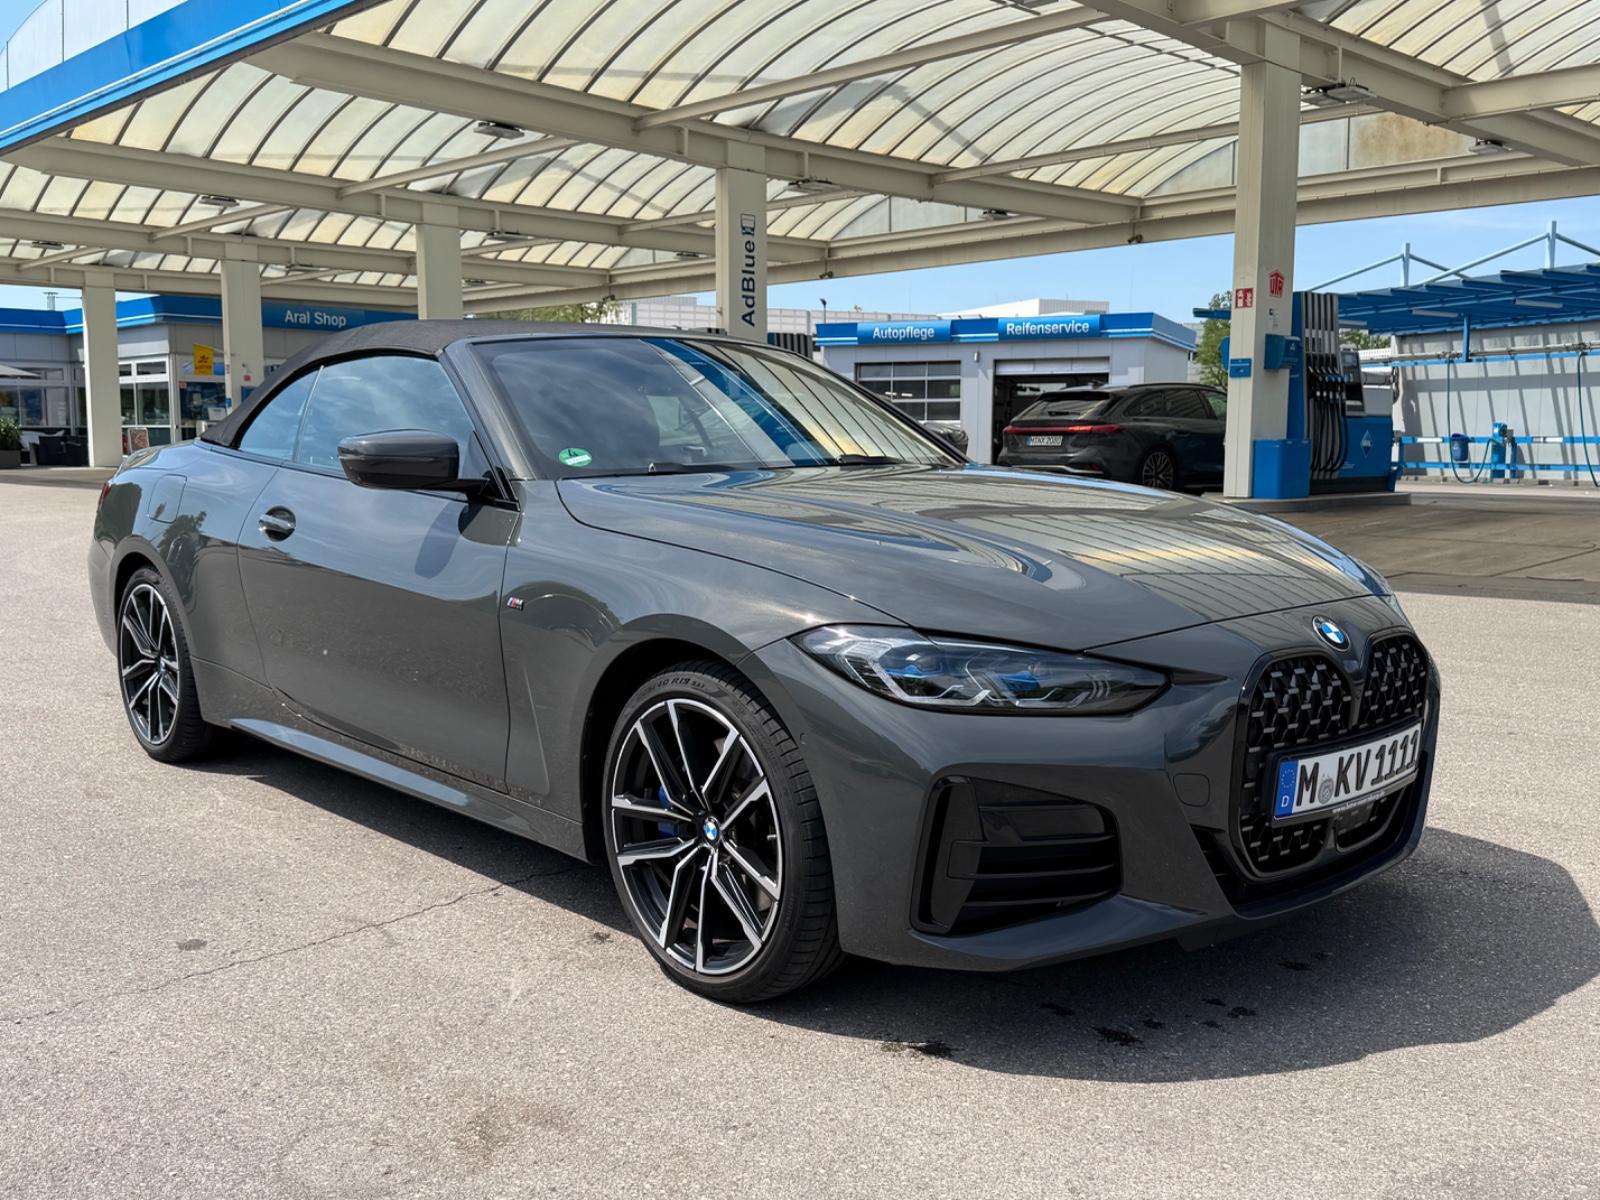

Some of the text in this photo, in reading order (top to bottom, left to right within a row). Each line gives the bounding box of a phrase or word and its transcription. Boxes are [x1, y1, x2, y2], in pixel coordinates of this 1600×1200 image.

[741, 240, 755, 327] AdBlue
[284, 309, 346, 328] Aral Shop
[872, 326, 935, 340] Autopflege
[1006, 320, 1089, 335] Reifenservice
[1296, 762, 1319, 807] M
[1281, 795, 1290, 807] D
